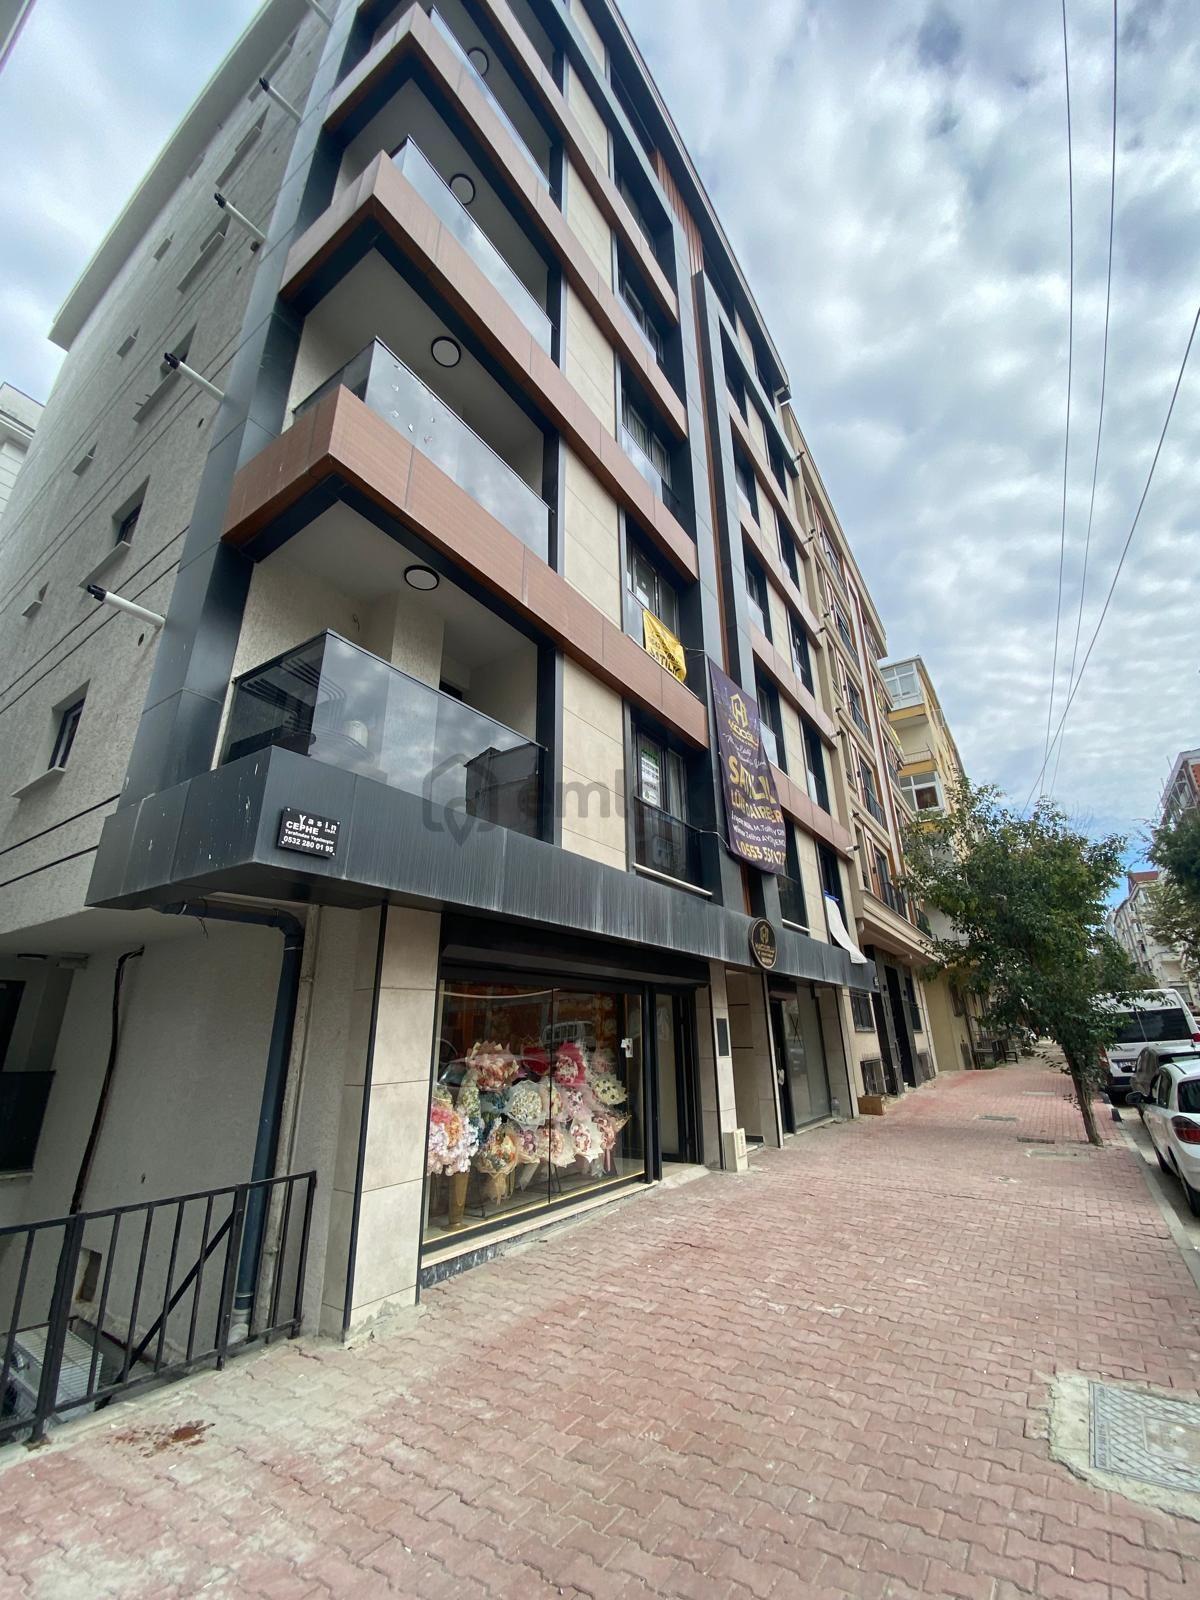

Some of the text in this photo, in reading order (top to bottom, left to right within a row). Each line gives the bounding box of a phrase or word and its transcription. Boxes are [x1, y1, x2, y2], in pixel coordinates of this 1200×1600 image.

[286, 820, 319, 836] CEPHE
[283, 835, 301, 846] 0532
[315, 842, 324, 851] 01
